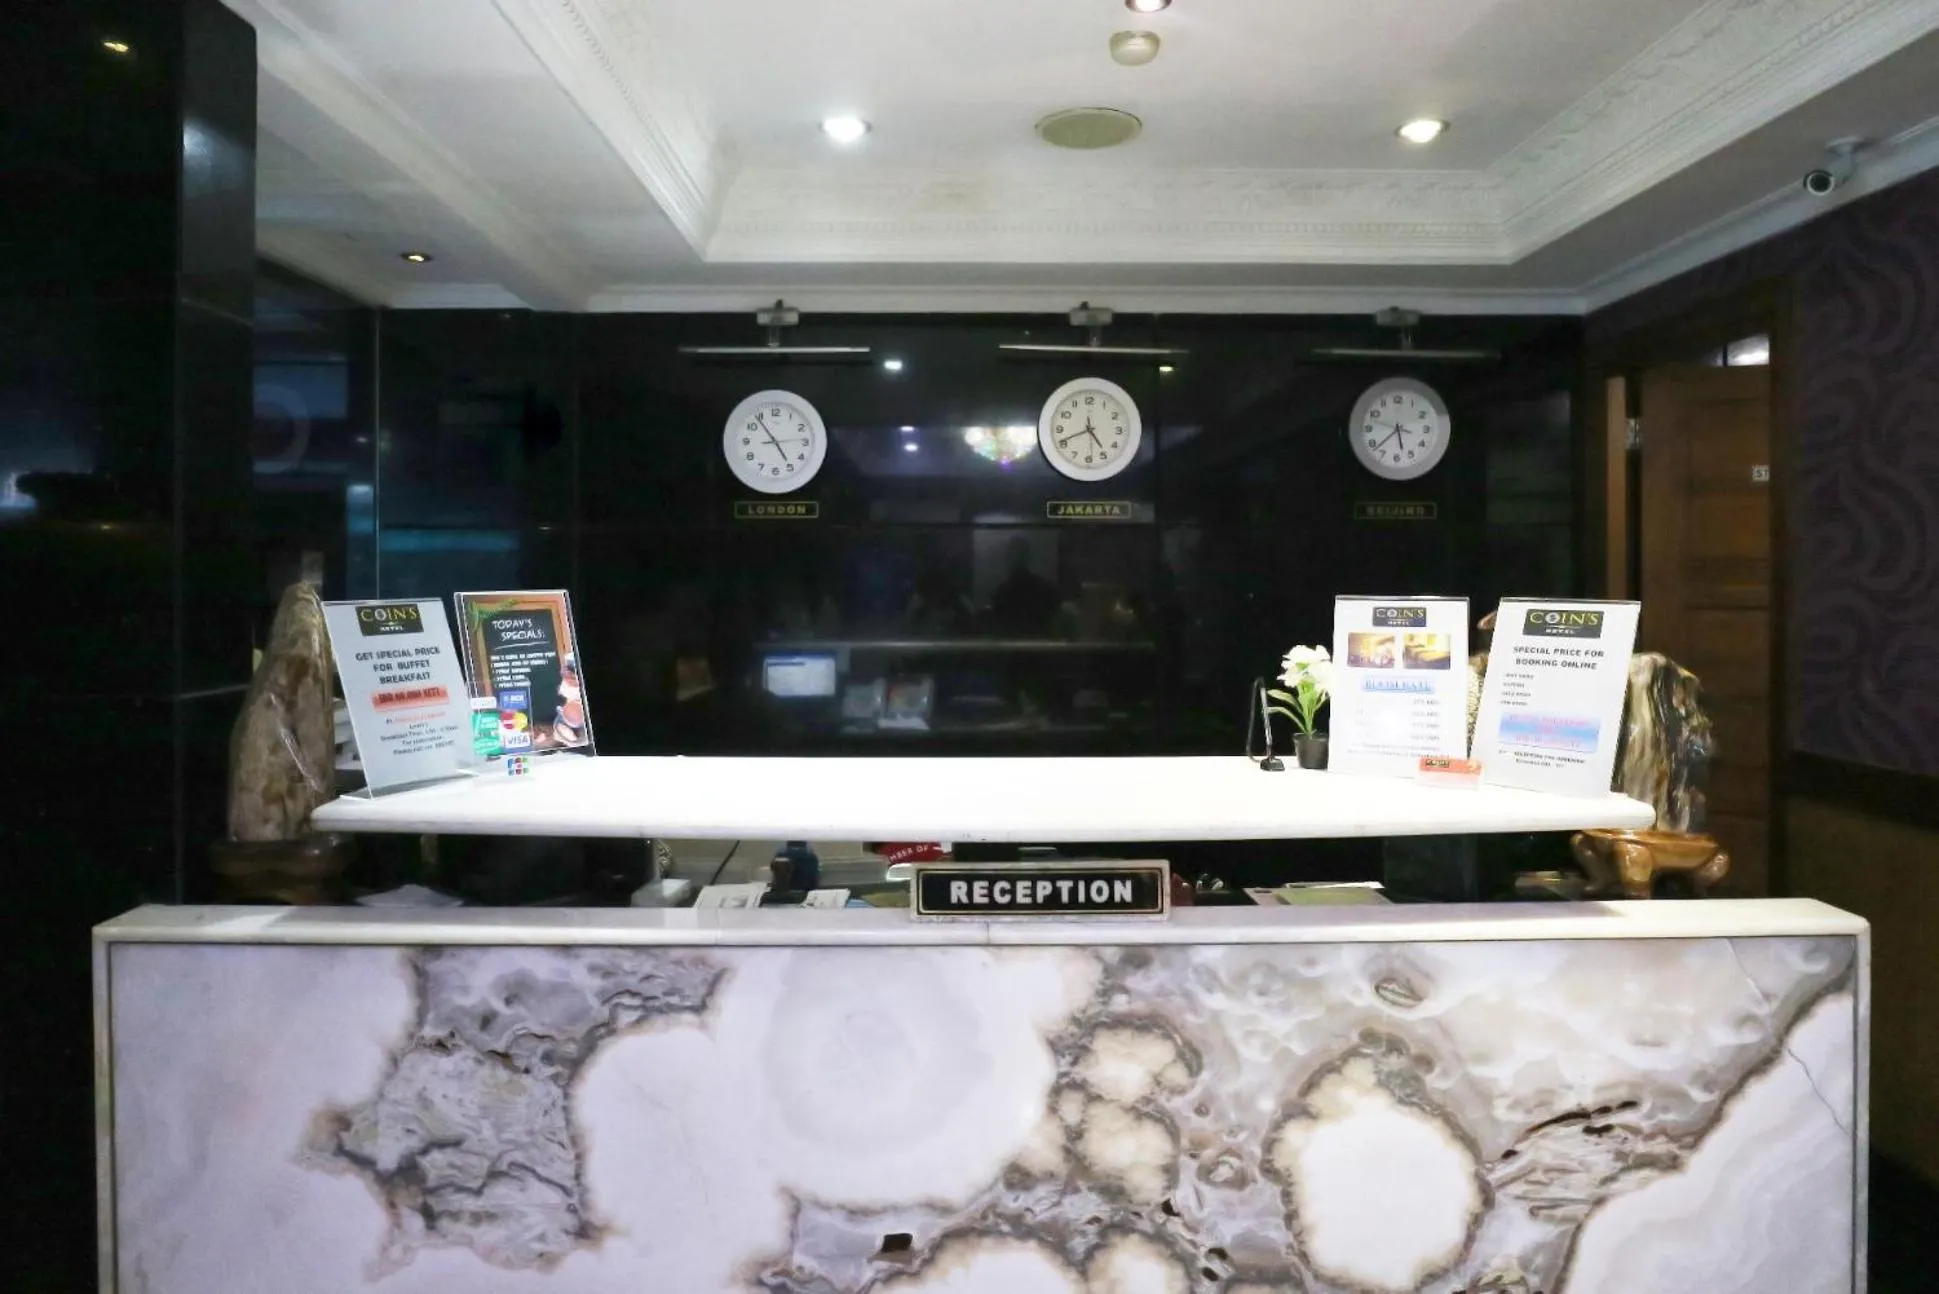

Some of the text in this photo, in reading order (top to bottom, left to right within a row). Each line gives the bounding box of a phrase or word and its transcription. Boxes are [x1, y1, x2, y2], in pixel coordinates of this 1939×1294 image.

[748, 505, 806, 514] LONDON
[1057, 504, 1120, 514] JAKARTA
[360, 606, 418, 621] COIN'S
[1375, 608, 1424, 618] COIN'S
[1530, 612, 1600, 625] COIN'S
[492, 618, 532, 630] TODAY'S
[355, 646, 440, 661] GET SPECIAL PRICE
[1513, 646, 1550, 654] SPECIAL
[1554, 648, 1582, 656] PRICE
[373, 660, 430, 672] FOR BUFFET
[1516, 658, 1598, 670] BOOKING ONLINE
[379, 672, 431, 684] BREAKFAST
[508, 734, 529, 744] VISA
[950, 880, 1132, 904] RECEPTION
